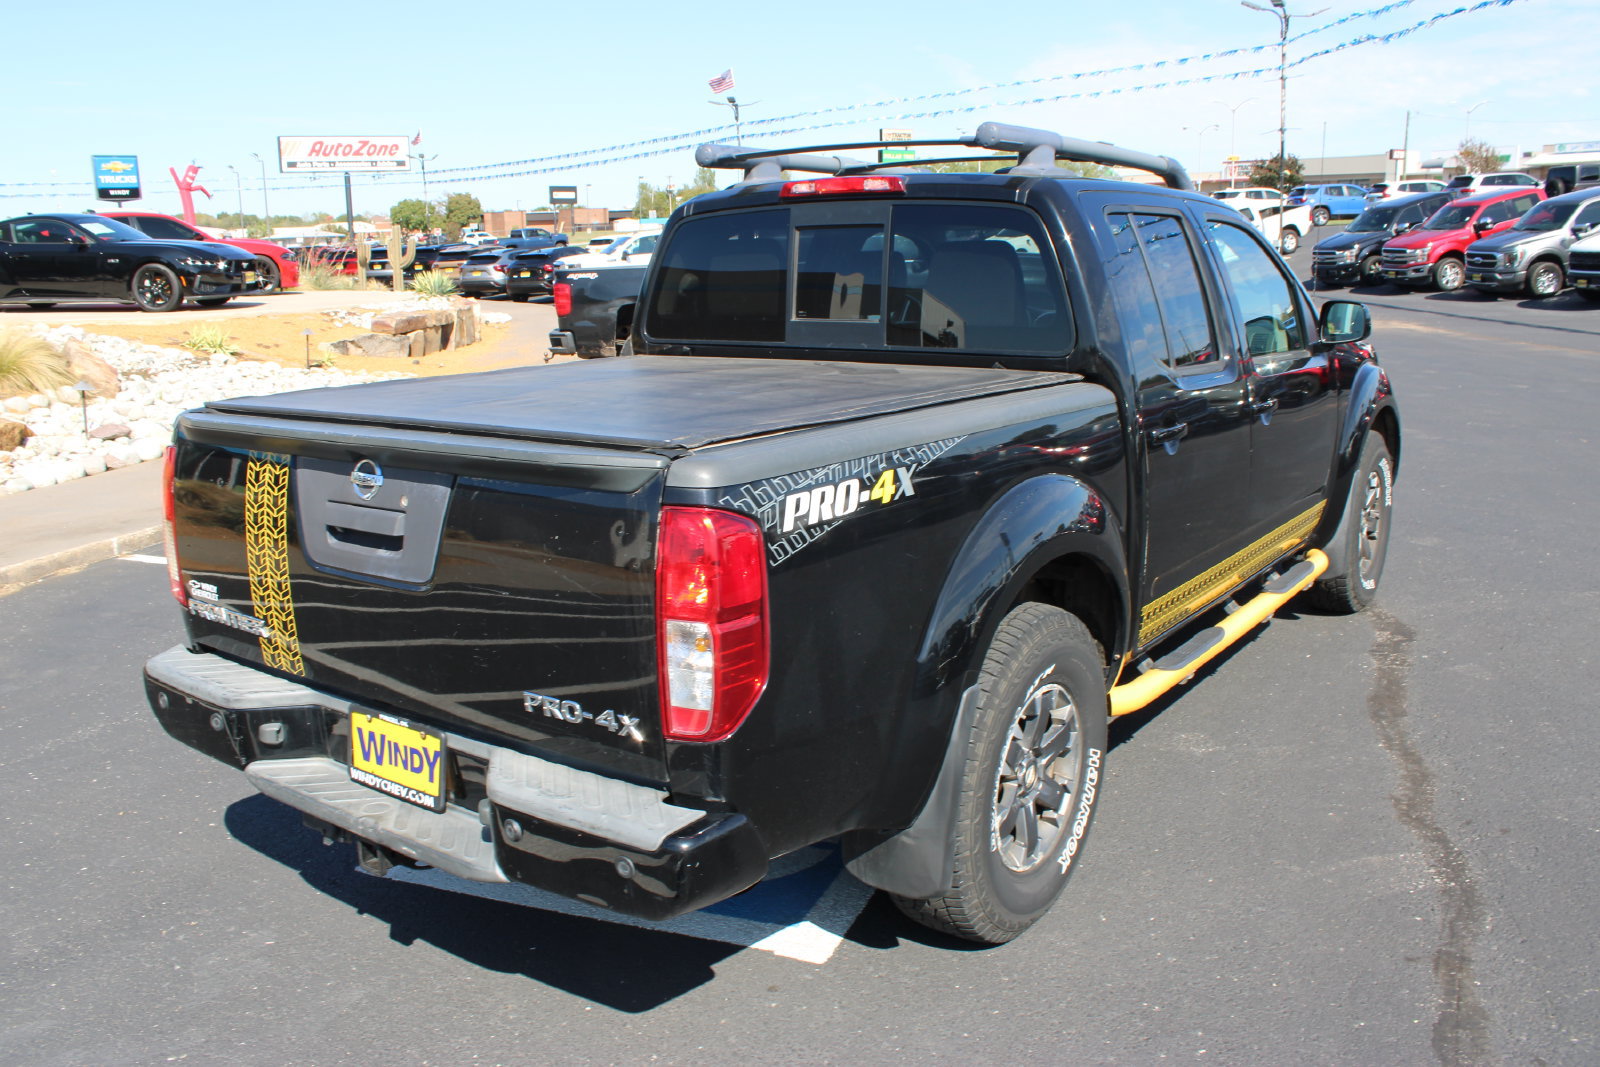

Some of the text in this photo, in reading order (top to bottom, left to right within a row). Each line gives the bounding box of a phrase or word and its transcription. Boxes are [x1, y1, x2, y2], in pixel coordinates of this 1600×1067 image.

[308, 140, 400, 157] AutoZone
[98, 175, 138, 183] TRUCKS
[782, 463, 917, 533] PRO-4X
[522, 690, 644, 741] PRO-4X
[356, 726, 441, 784] WINDY
[350, 766, 435, 808] WINDYCHEV.COM
